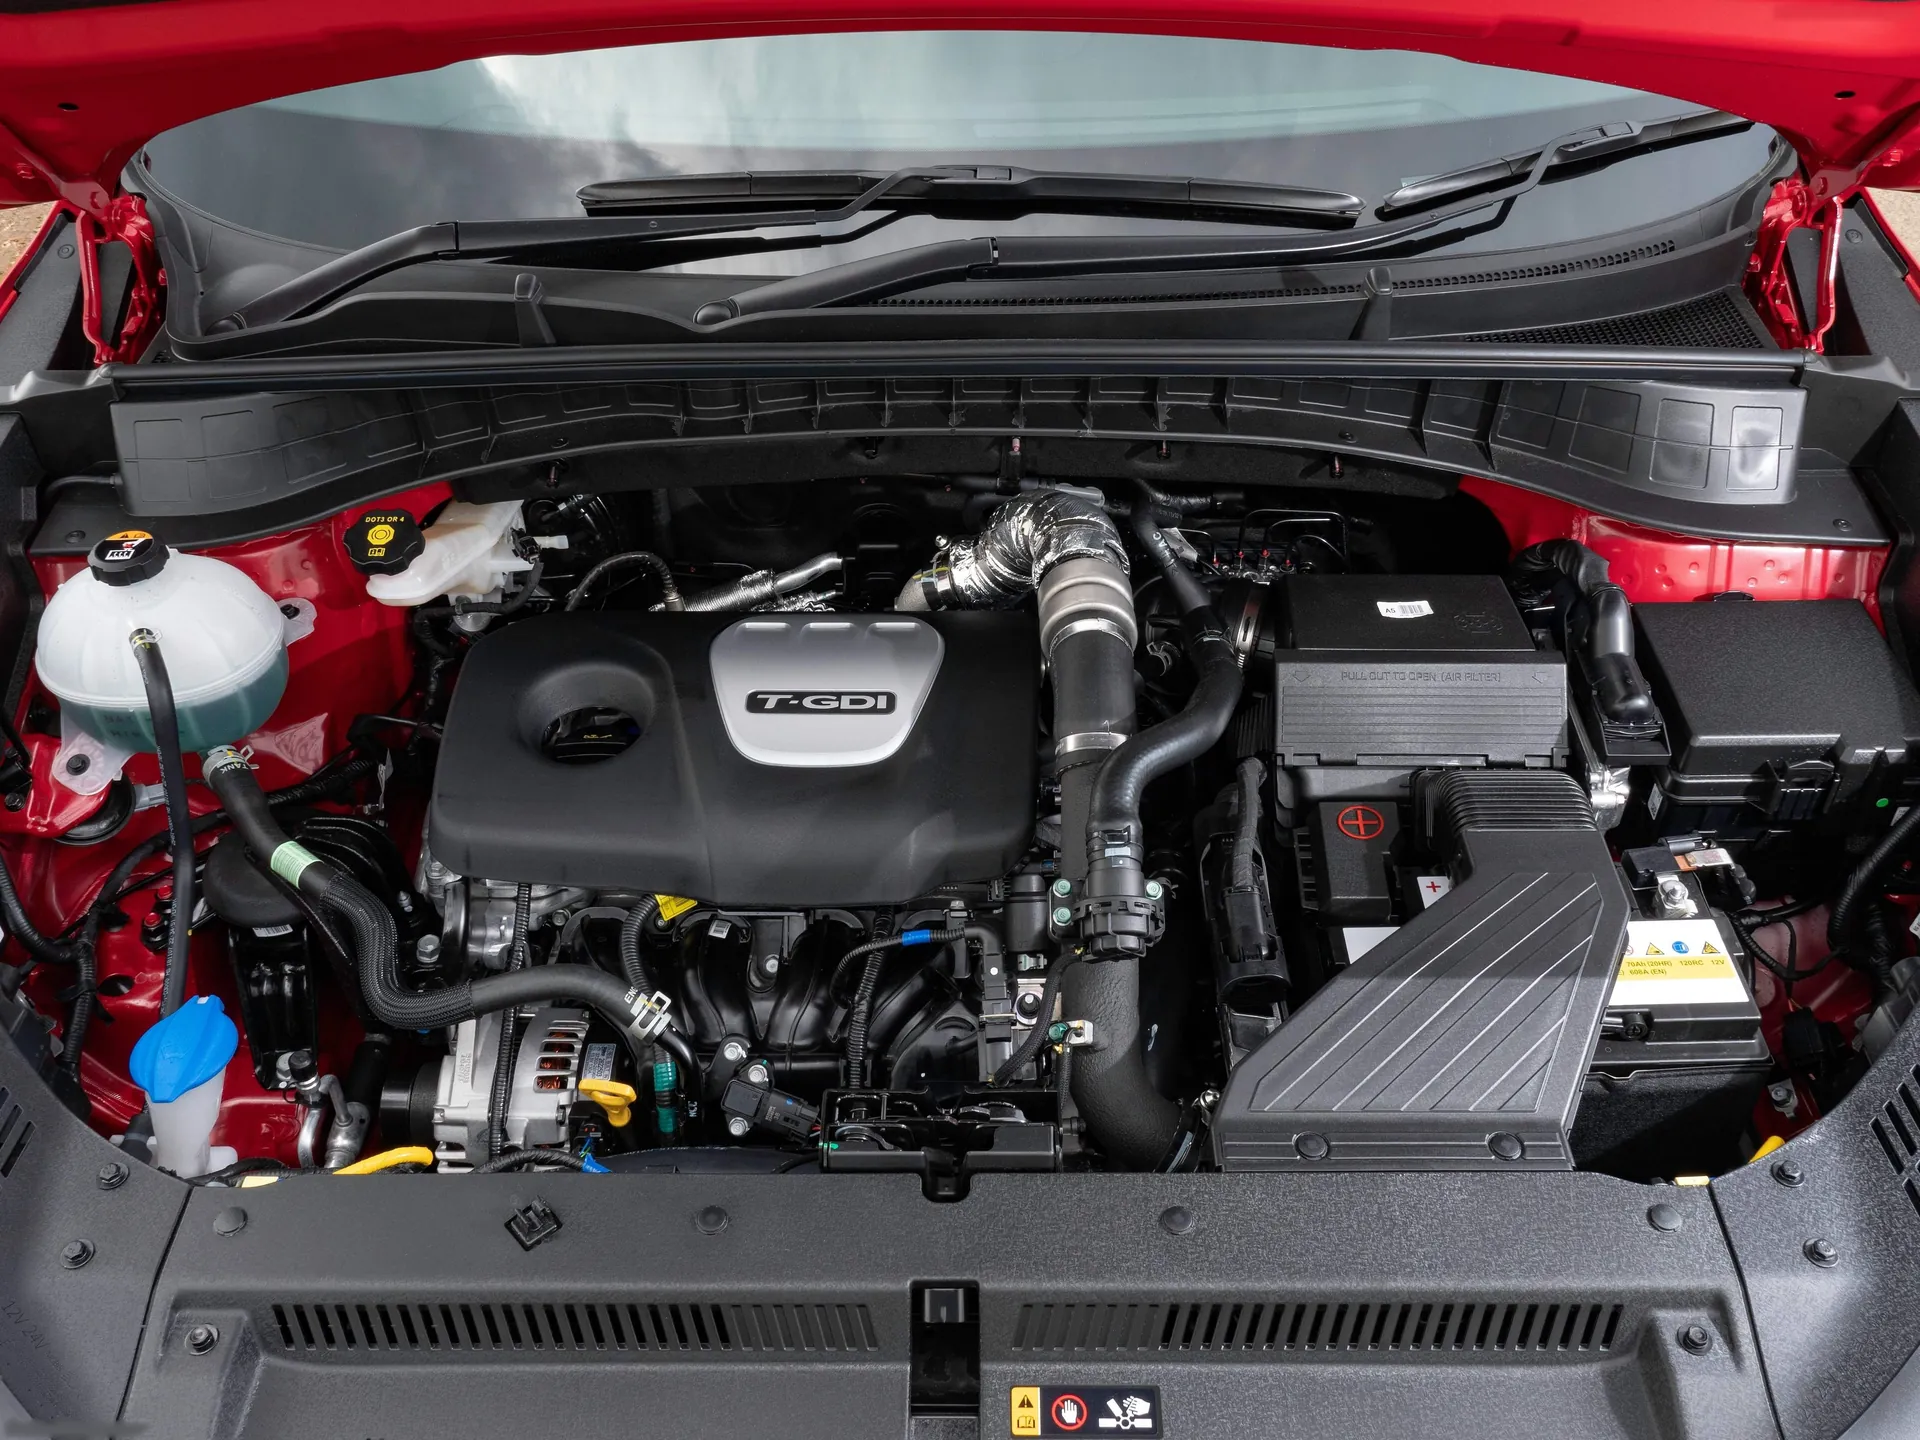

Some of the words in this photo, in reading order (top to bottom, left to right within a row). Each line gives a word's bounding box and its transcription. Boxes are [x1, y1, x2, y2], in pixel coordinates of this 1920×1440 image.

[1341, 671, 1367, 681] PULL
[1369, 671, 1390, 681] OUT
[1393, 672, 1406, 681] TO
[1408, 672, 1436, 681] OPEN
[1441, 672, 1462, 682] (AIR
[1464, 672, 1501, 682] FILTER)
[756, 694, 887, 710] T-GDI
[220, 762, 249, 774] TANK
